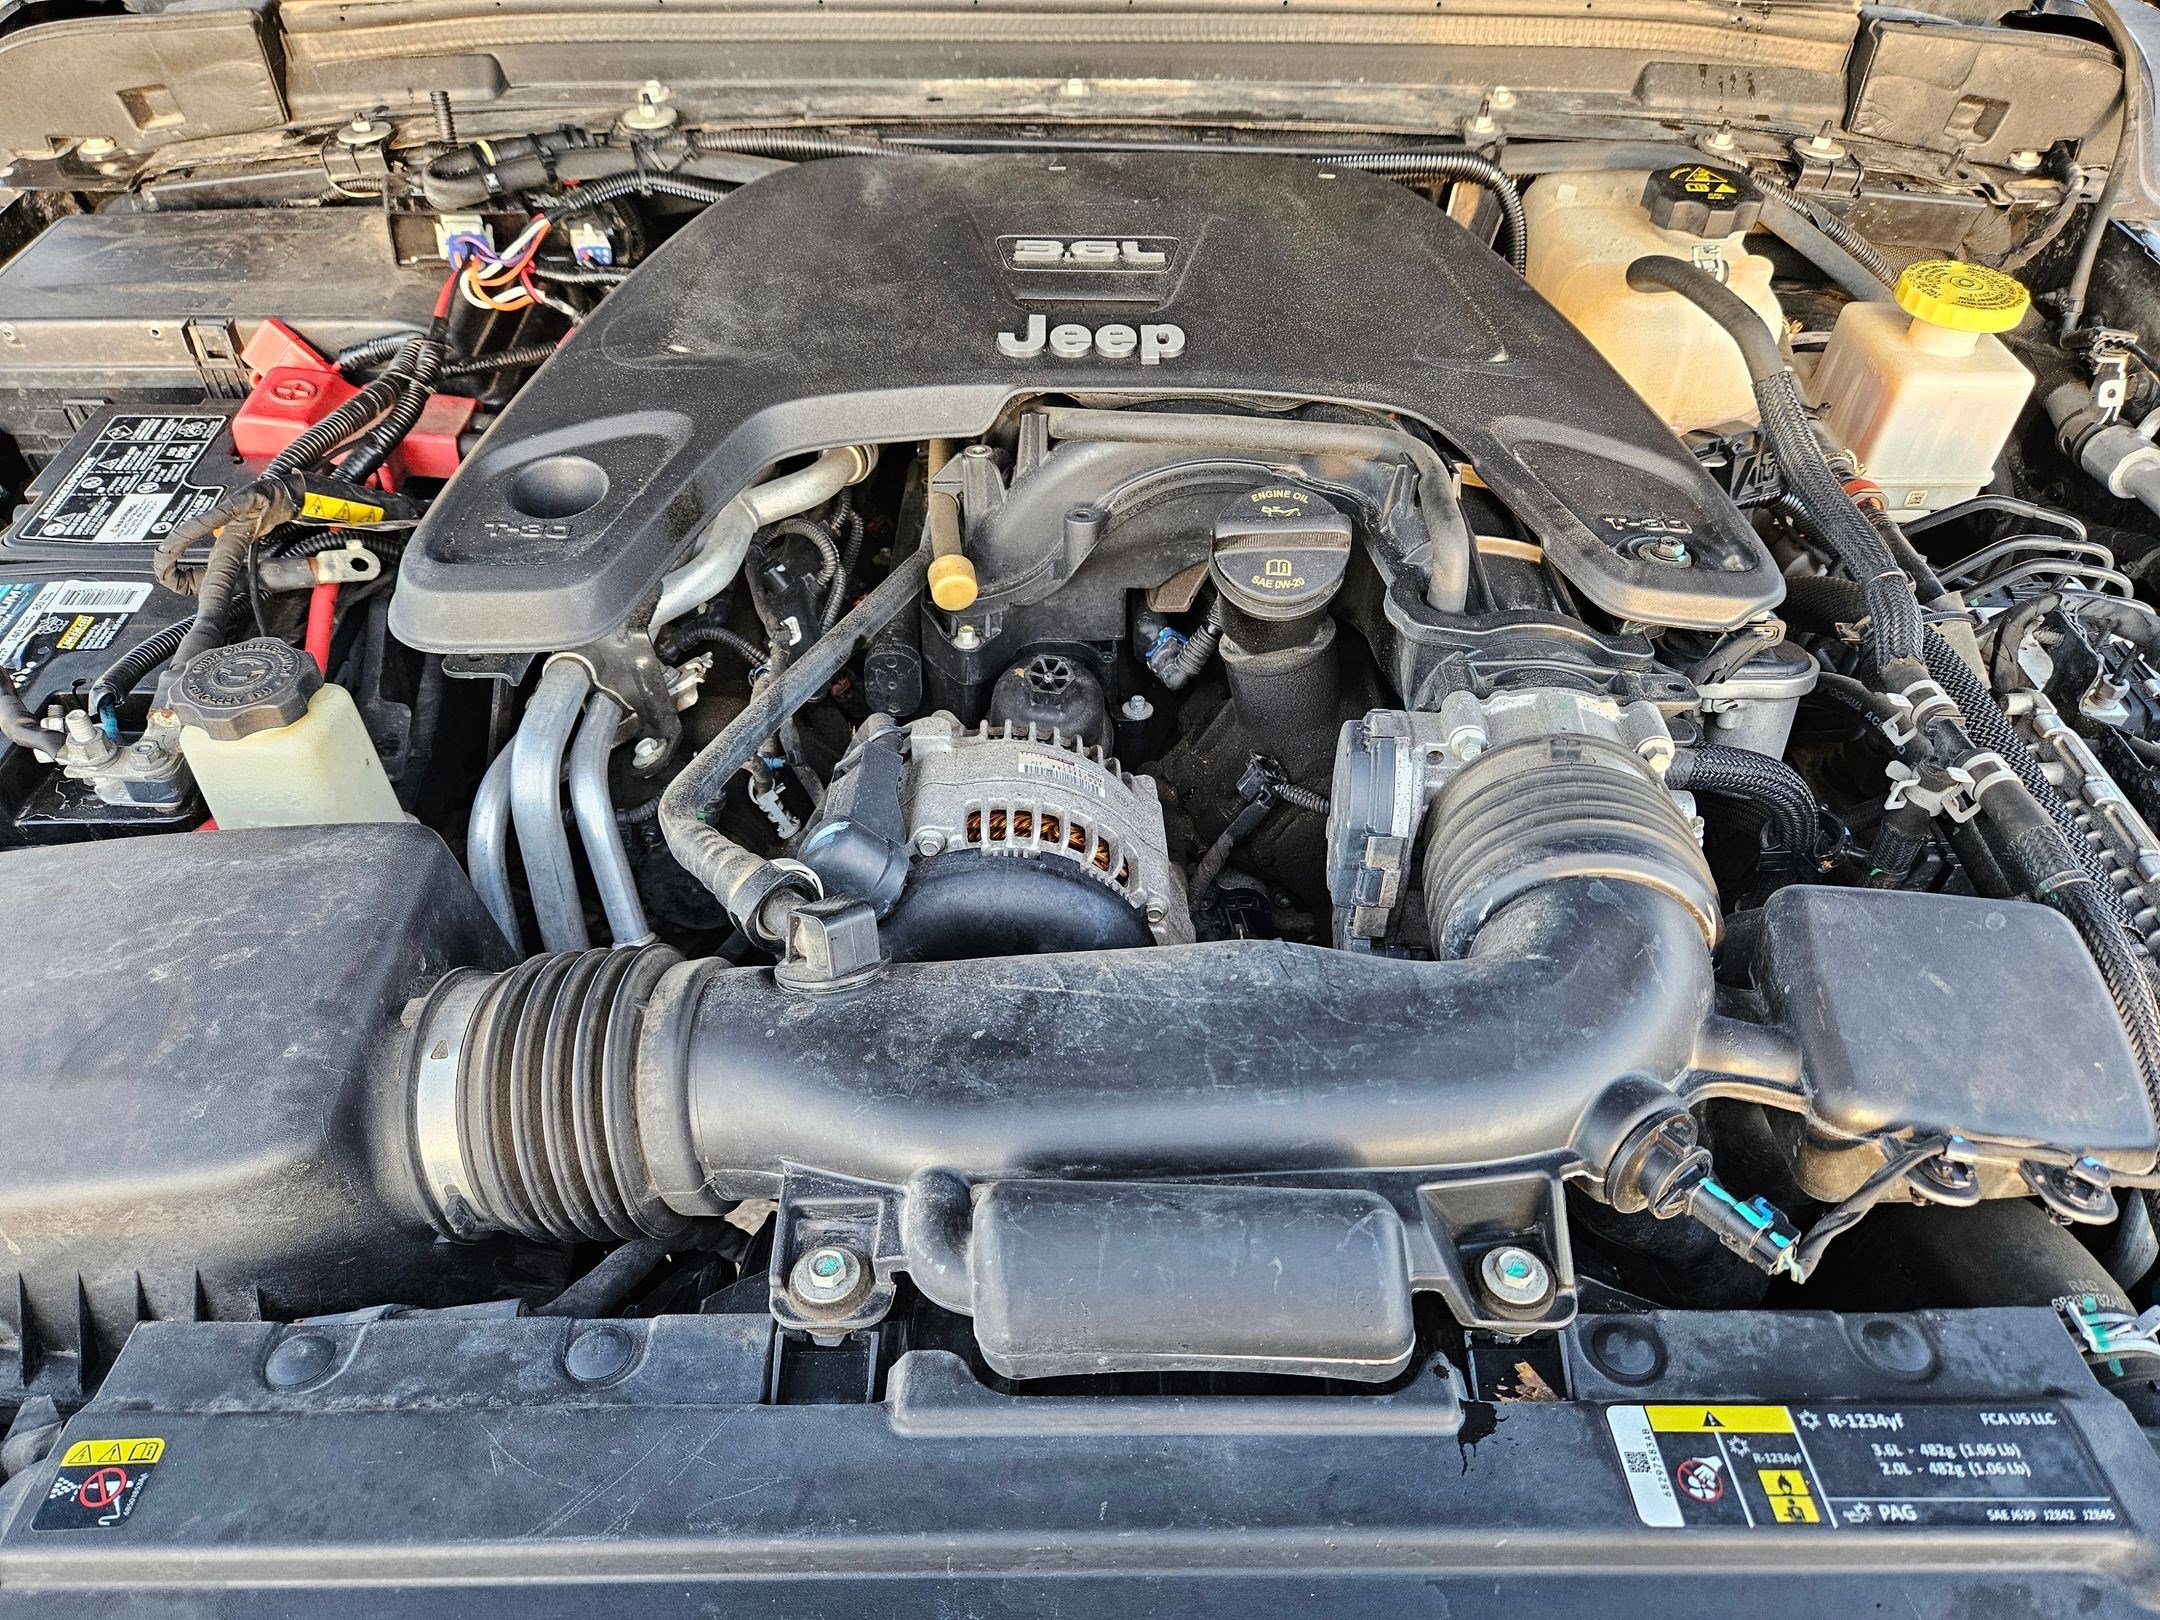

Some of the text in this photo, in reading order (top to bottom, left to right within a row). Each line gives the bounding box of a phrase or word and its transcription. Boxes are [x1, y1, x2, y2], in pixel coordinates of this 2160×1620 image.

[1012, 239, 1166, 262] 3.6L
[997, 313, 1186, 365] Jeep
[1251, 490, 1309, 504] ENGINE OIL
[1252, 575, 1305, 590] SAE 0W-20
[1827, 1412, 1904, 1432] R-1234yf
[1980, 1412, 2057, 1426] FCA US LLC
[1752, 1452, 1802, 1466] R-1234yf
[1871, 1443, 1904, 1457] 3.6L
[1920, 1443, 1957, 1459] 482g
[1959, 1443, 1997, 1459] (1.06
[1997, 1443, 2021, 1459] Lb)
[1880, 1461, 1913, 1476] 2.0L
[1929, 1461, 1966, 1478] 482g
[1968, 1461, 2006, 1478] (1.06
[2006, 1461, 2031, 1478] Lb)
[1878, 1503, 1917, 1521] PAG
[1986, 1509, 2010, 1521] SAE
